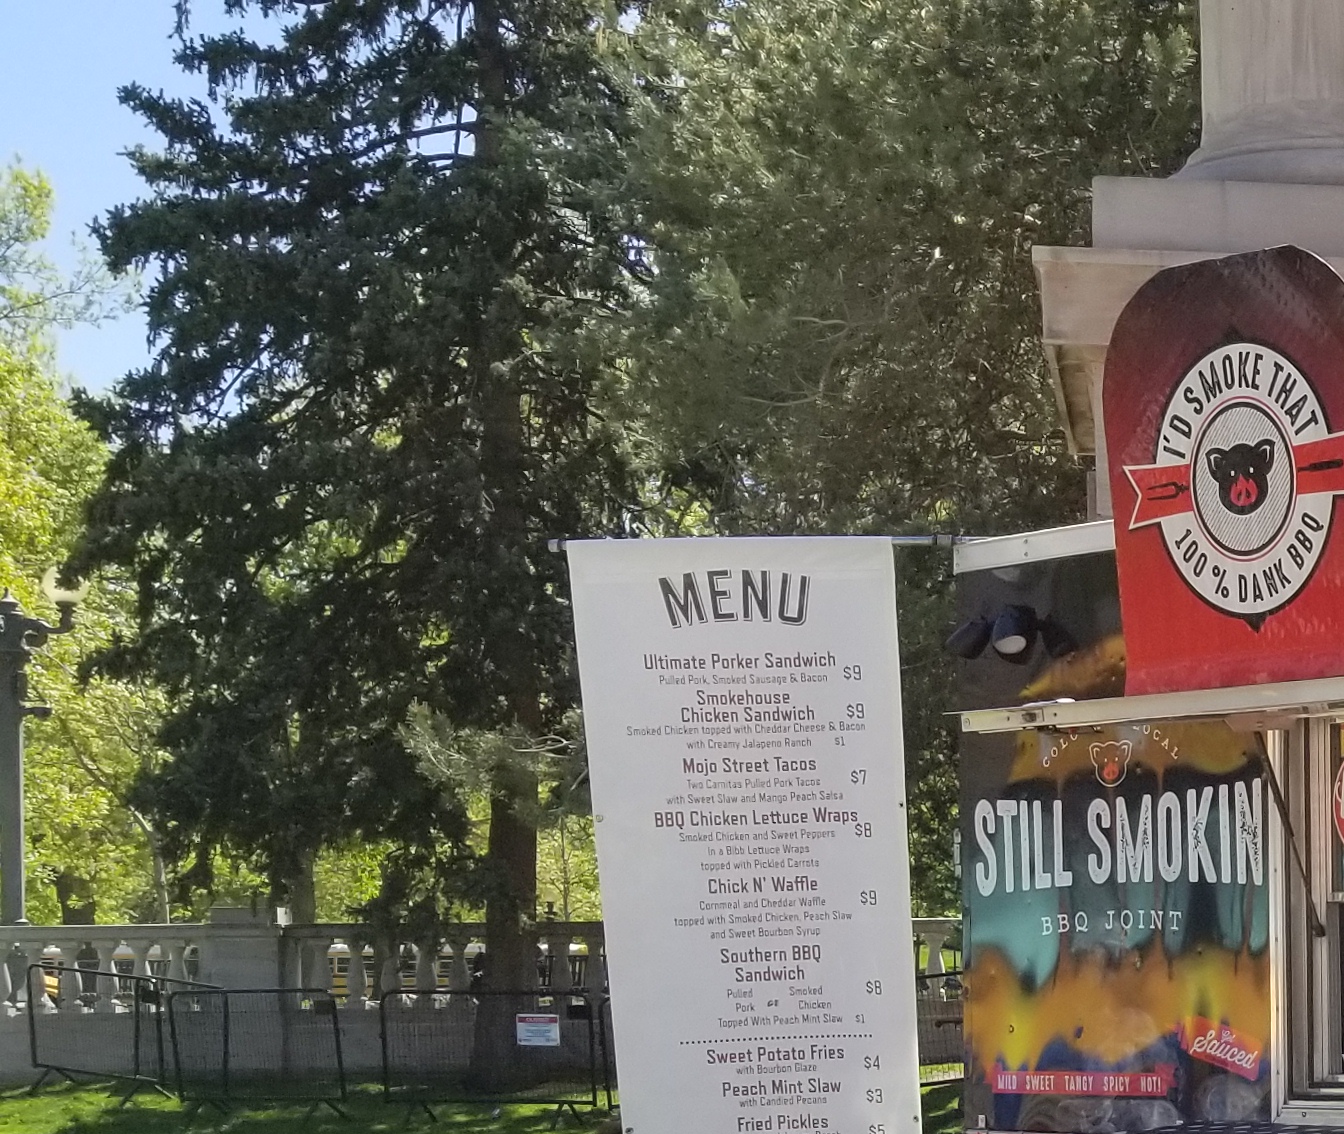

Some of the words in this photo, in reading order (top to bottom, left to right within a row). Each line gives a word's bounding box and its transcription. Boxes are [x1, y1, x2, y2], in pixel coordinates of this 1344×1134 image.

[1163, 413, 1194, 460] I'D
[1191, 351, 1264, 415] SMOKE
[1266, 359, 1319, 436] THAT
[1174, 528, 1208, 578] 100
[1212, 564, 1230, 599] %
[1238, 558, 1292, 603] DANK
[1287, 512, 1325, 571] BBQ
[658, 569, 811, 629] MENU
[644, 654, 706, 670] Ultimate
[711, 653, 759, 669] Porker
[765, 652, 836, 668] Sandwich
[843, 665, 862, 680] $9
[696, 690, 790, 706] Smokehouse
[681, 707, 738, 723] Chicken
[744, 706, 815, 721] Sandwich
[846, 703, 865, 719] $9
[627, 726, 661, 736] Smoked
[664, 725, 698, 735] Chicken
[702, 724, 731, 735] topped
[733, 724, 752, 734] with
[755, 723, 791, 734] Cheddar
[794, 723, 826, 732] Cheese
[828, 722, 837, 731] &
[839, 721, 866, 731] Bacon
[687, 740, 705, 749] with
[708, 739, 740, 750] Creamy
[742, 738, 782, 749] Jalapeno
[785, 738, 812, 747] Ranch
[683, 758, 717, 776] Mojo
[723, 758, 769, 773] Street
[774, 757, 817, 771] Tacos
[850, 769, 867, 785] $7
[654, 811, 685, 829] BBQ
[690, 811, 748, 826] Chicken
[753, 809, 808, 825] Lettuce
[812, 807, 858, 824] Wraps
[855, 823, 872, 838] $8
[974, 799, 1073, 896] STILL
[1087, 778, 1263, 886] SMOKIN
[708, 878, 748, 894] Chick
[753, 877, 766, 892] N'
[771, 876, 818, 891] Waffle
[860, 890, 877, 905] $9
[1041, 911, 1088, 936] BBQ
[1105, 910, 1182, 931] JOINT
[720, 948, 787, 963] Southern
[792, 945, 821, 963] BBQ
[735, 966, 805, 983] Sandwich
[866, 980, 882, 995] $8
[718, 1017, 749, 1028] Topped
[751, 1015, 771, 1026] With
[774, 1015, 800, 1025] Peach
[802, 1014, 820, 1024] Mint
[823, 1013, 843, 1023] Slaw
[855, 1014, 865, 1024] $1
[707, 1048, 753, 1064] Sweet
[758, 1046, 805, 1062] Potato
[810, 1045, 845, 1060] Fries
[864, 1055, 881, 1071] $4
[1190, 1030, 1258, 1069] Sauced
[722, 1082, 766, 1097] Peach
[772, 1080, 803, 1095] Mint
[808, 1078, 841, 1093] Slaw
[866, 1088, 883, 1104] $3
[998, 1074, 1017, 1090] MILD
[1025, 1075, 1055, 1090] SWEET
[1064, 1075, 1093, 1091] TANGY
[1103, 1076, 1130, 1092] SPICY
[1140, 1076, 1161, 1092] HOT!
[738, 1116, 772, 1132] Fried
[777, 1114, 829, 1130] Pickles
